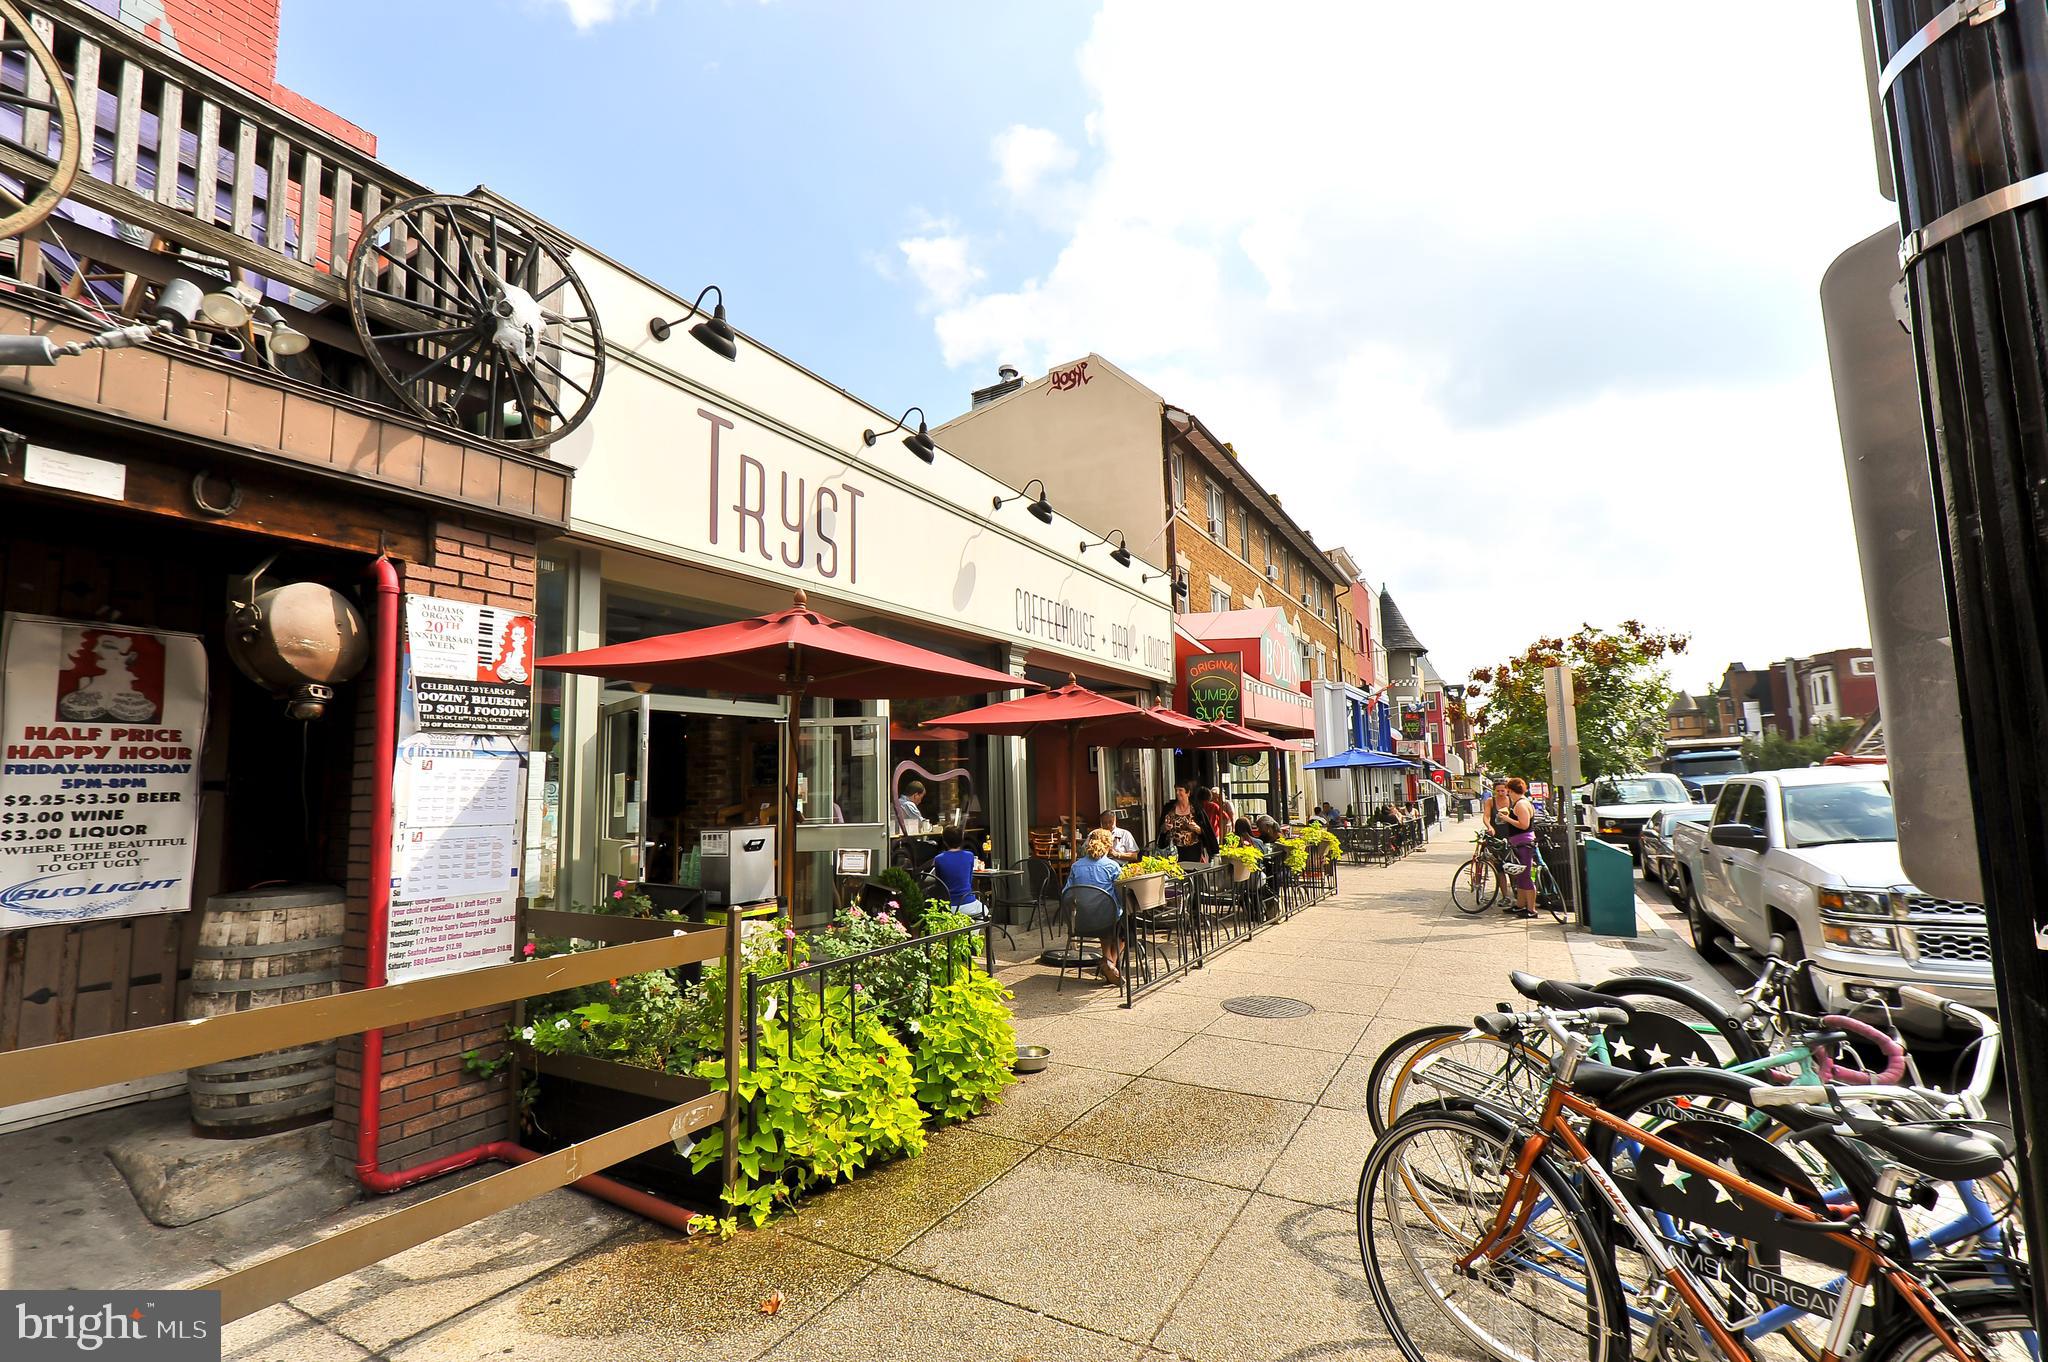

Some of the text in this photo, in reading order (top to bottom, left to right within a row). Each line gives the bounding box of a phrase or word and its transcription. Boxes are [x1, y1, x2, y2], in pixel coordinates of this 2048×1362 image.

[422, 603, 464, 615] MADAMS
[1015, 587, 1096, 652] COFFEEHOUSE
[1112, 623, 1130, 661] BAR
[1143, 633, 1171, 673] LOUNGE
[428, 640, 456, 650] WEEK
[1190, 659, 1238, 677] ORIGINAL
[421, 682, 469, 693] CELEBRATE
[479, 686, 504, 696] YEARS
[504, 688, 516, 696] OF
[1191, 687, 1239, 702] JUMBO
[436, 704, 471, 715] SOUL
[1195, 705, 1235, 720] SLICE
[25, 726, 183, 742] HALF PRICE
[7, 745, 193, 760] HAPPY HOUR
[4, 763, 193, 775] FRIDAY-WEDNESDAY
[61, 778, 147, 789] 5PM-8PM
[4, 791, 181, 807] $2.25-$3.50 BEER
[2, 809, 125, 825] $3.00 WINE
[1, 824, 147, 842] $3.00 LIQUOR
[71, 842, 103, 852] THE
[108, 837, 188, 850] BEAUTIFUL
[53, 849, 138, 862] PEOPLE GO
[37, 863, 62, 873] TO
[67, 861, 99, 871] GET
[14, 878, 183, 901] BUD LIGHT
[424, 915, 437, 924] Price
[430, 924, 444, 933] Price
[424, 935, 438, 944] Price
[388, 949, 406, 960] Friday:
[1748, 1271, 1839, 1316] ORGAN
